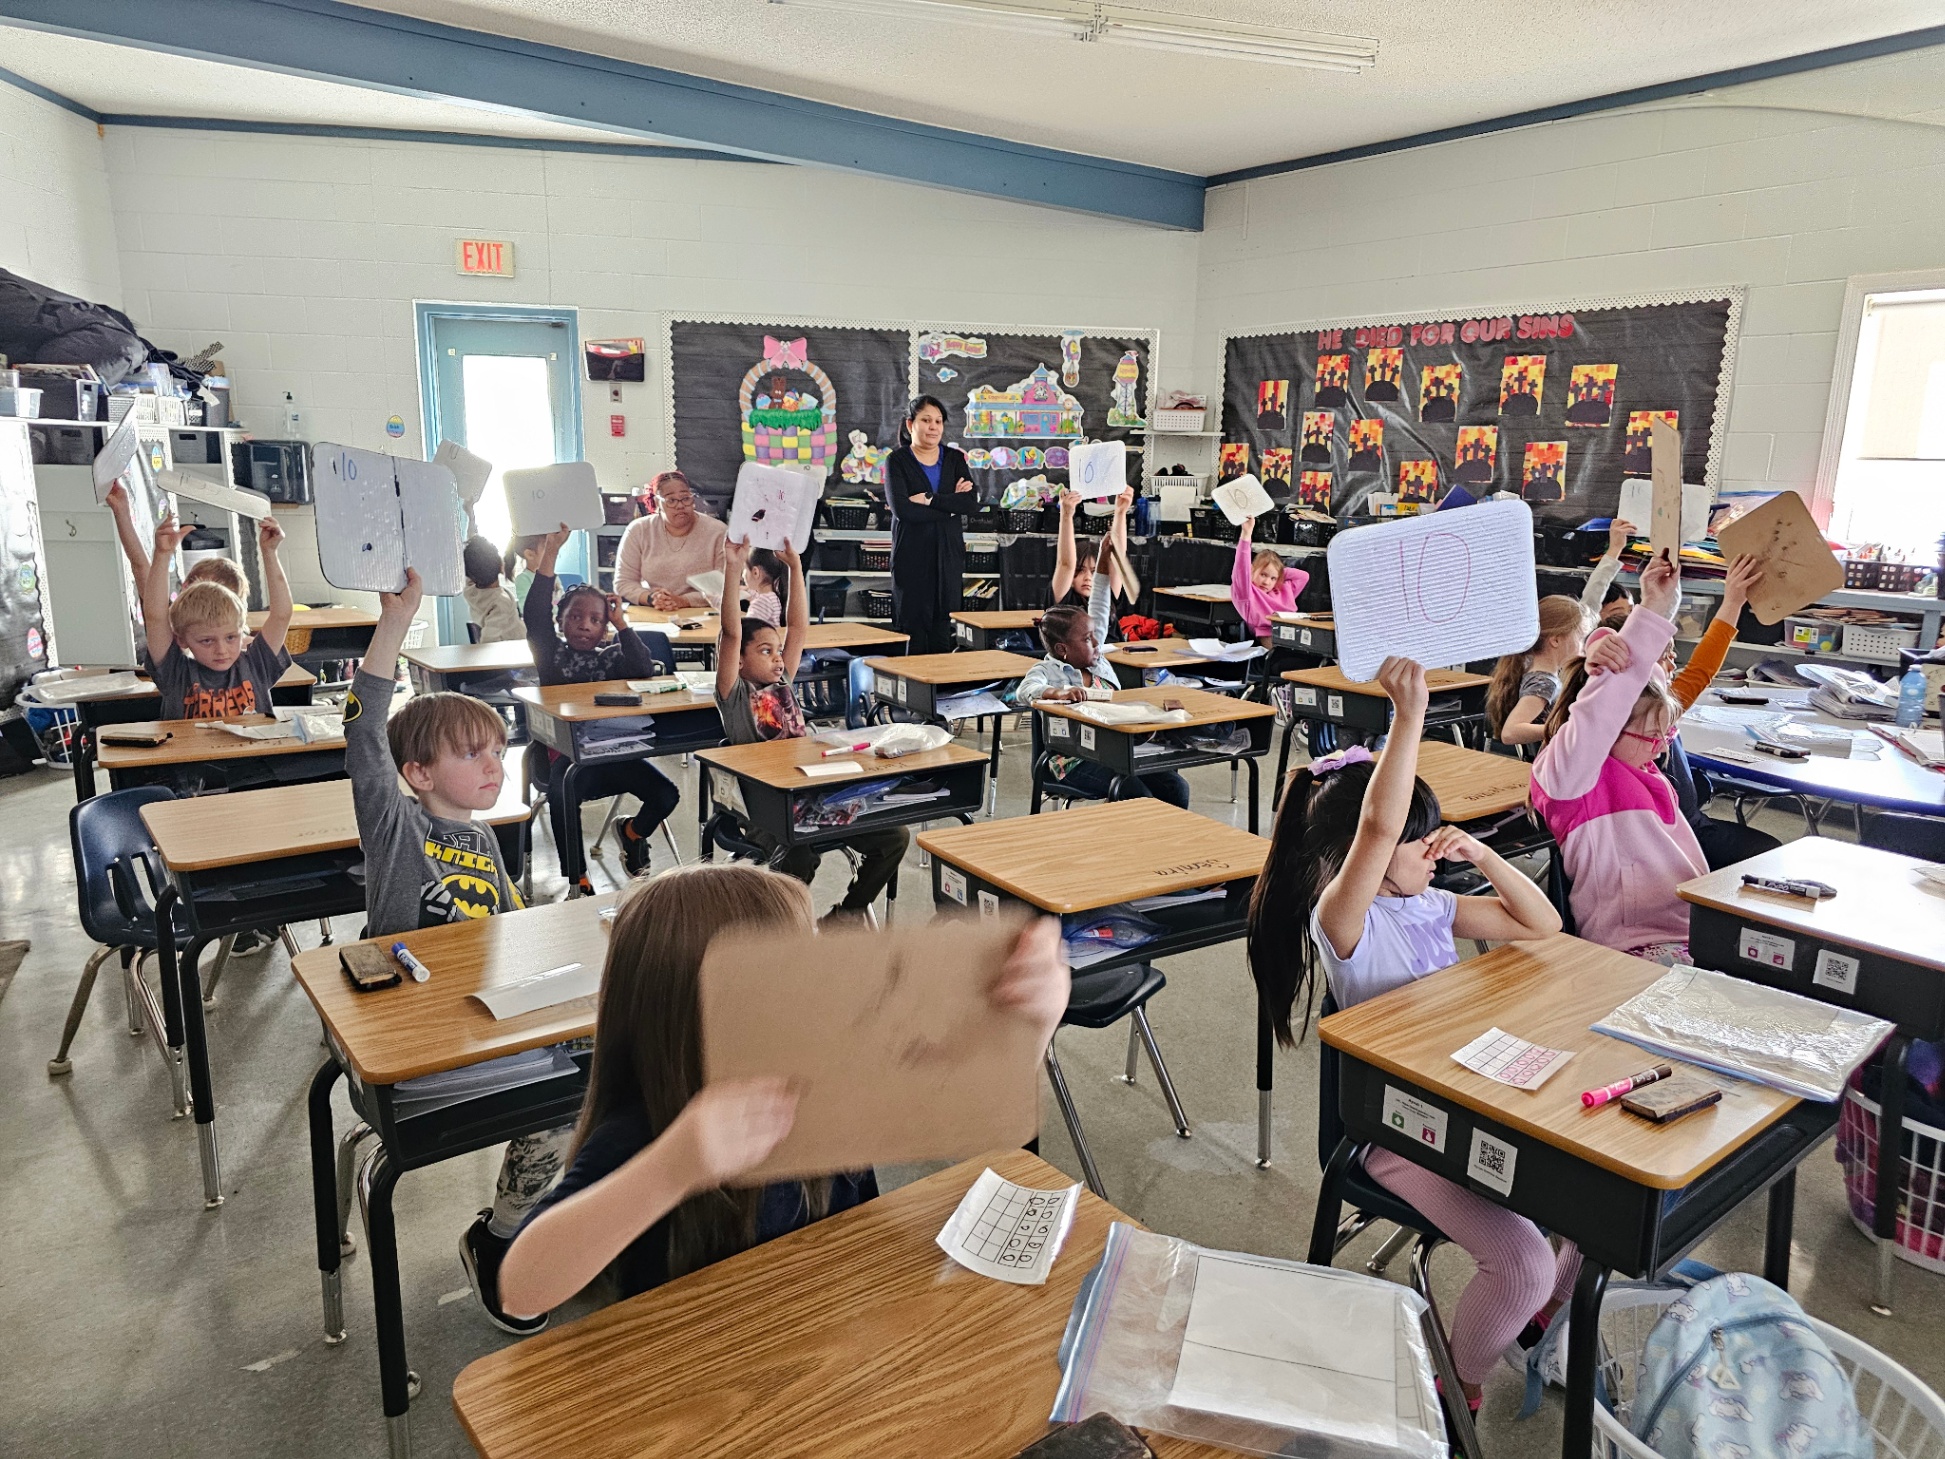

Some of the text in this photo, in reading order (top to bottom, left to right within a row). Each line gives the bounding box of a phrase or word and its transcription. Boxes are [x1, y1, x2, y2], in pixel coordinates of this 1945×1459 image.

[462, 241, 503, 273] EXIT
[1317, 314, 1576, 350] HE DIED FOR OUR SINS
[1078, 458, 1095, 484] 10
[531, 488, 545, 500] 10
[1399, 532, 1472, 625] 10
